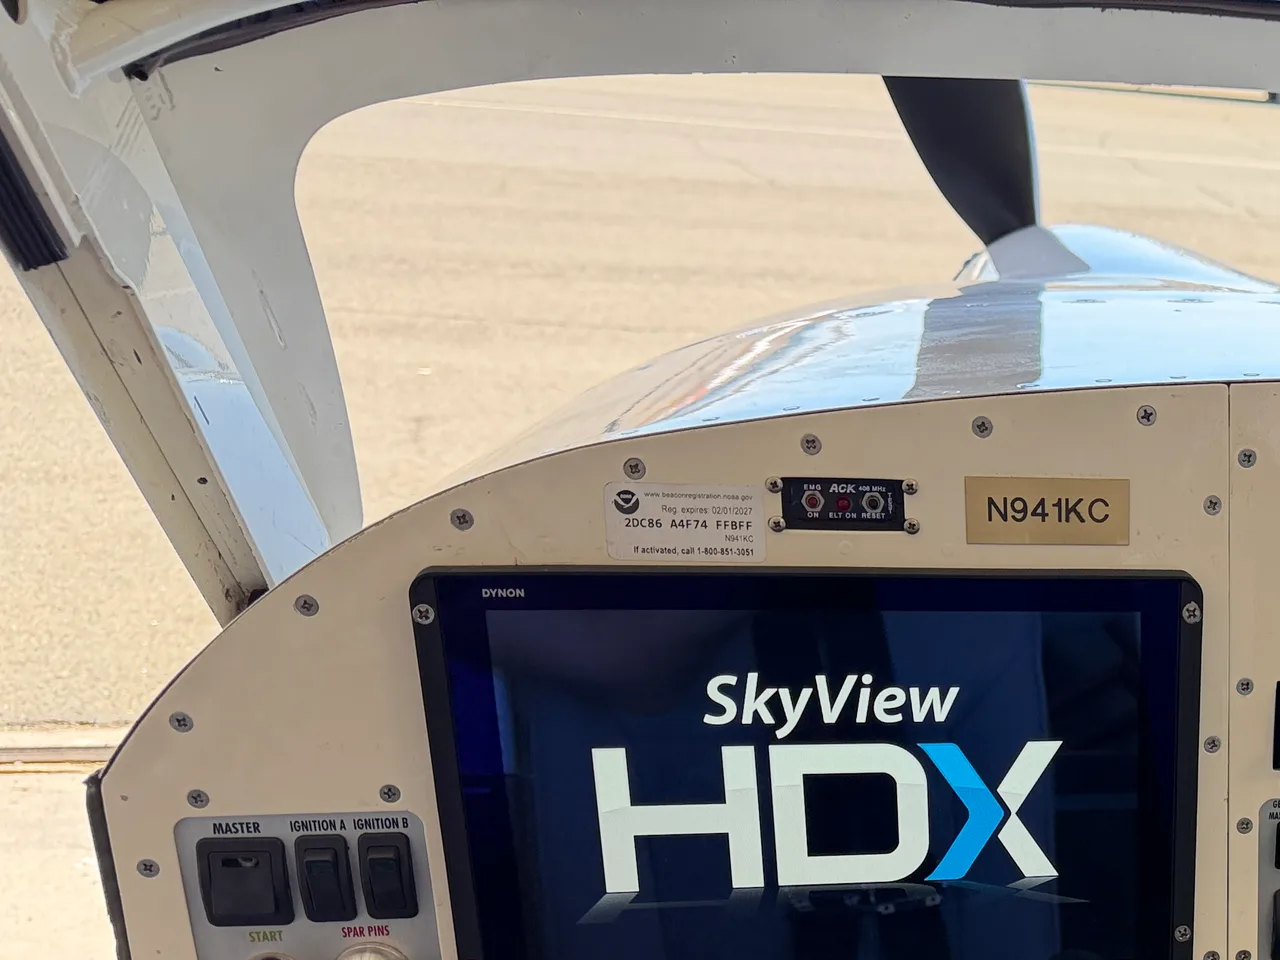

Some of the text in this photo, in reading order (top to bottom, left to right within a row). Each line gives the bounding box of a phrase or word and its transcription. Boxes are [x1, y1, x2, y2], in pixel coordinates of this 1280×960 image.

[829, 483, 856, 493] ACK
[681, 506, 710, 515] expires:
[712, 506, 753, 515] 02/01/2027
[986, 496, 1110, 524] N941KC
[624, 518, 753, 530] 2DC86 A4F74 FFBFF
[724, 534, 754, 543] N941KC
[633, 546, 754, 556] If activated, call 1-800-851-3051
[481, 588, 526, 599] DYNON
[703, 673, 960, 738] SkyView
[592, 740, 1064, 893] HDX
[212, 821, 261, 835] MASTER
[289, 820, 347, 833] IGNITION A
[352, 817, 409, 830] IGNITION B
[248, 930, 284, 942] START
[341, 924, 390, 938] SPAR PINS
